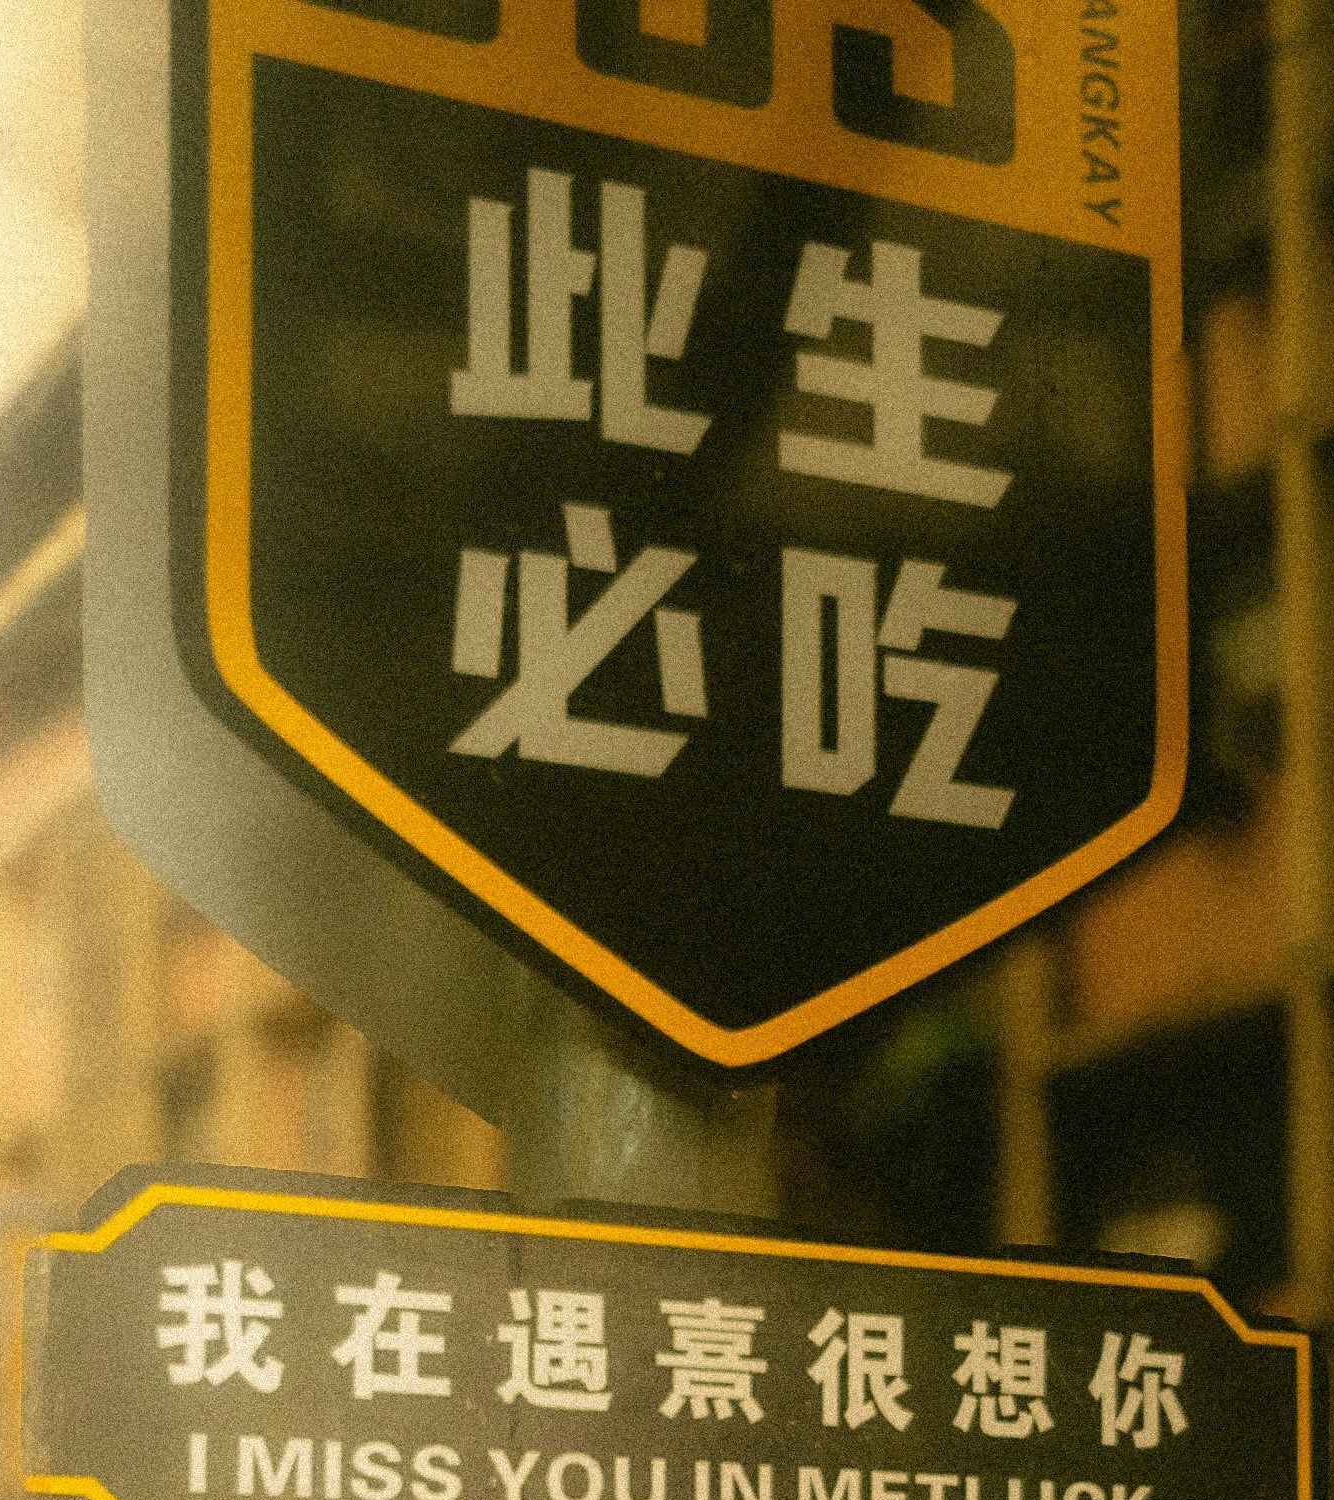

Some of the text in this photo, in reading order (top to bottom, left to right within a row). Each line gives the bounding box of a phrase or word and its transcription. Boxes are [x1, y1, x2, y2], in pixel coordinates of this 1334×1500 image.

[451, 168, 1014, 509] 此生
[448, 502, 1018, 831] 必吃
[156, 1259, 1189, 1450] 我在遇熹很想你
[187, 1433, 208, 1494] I
